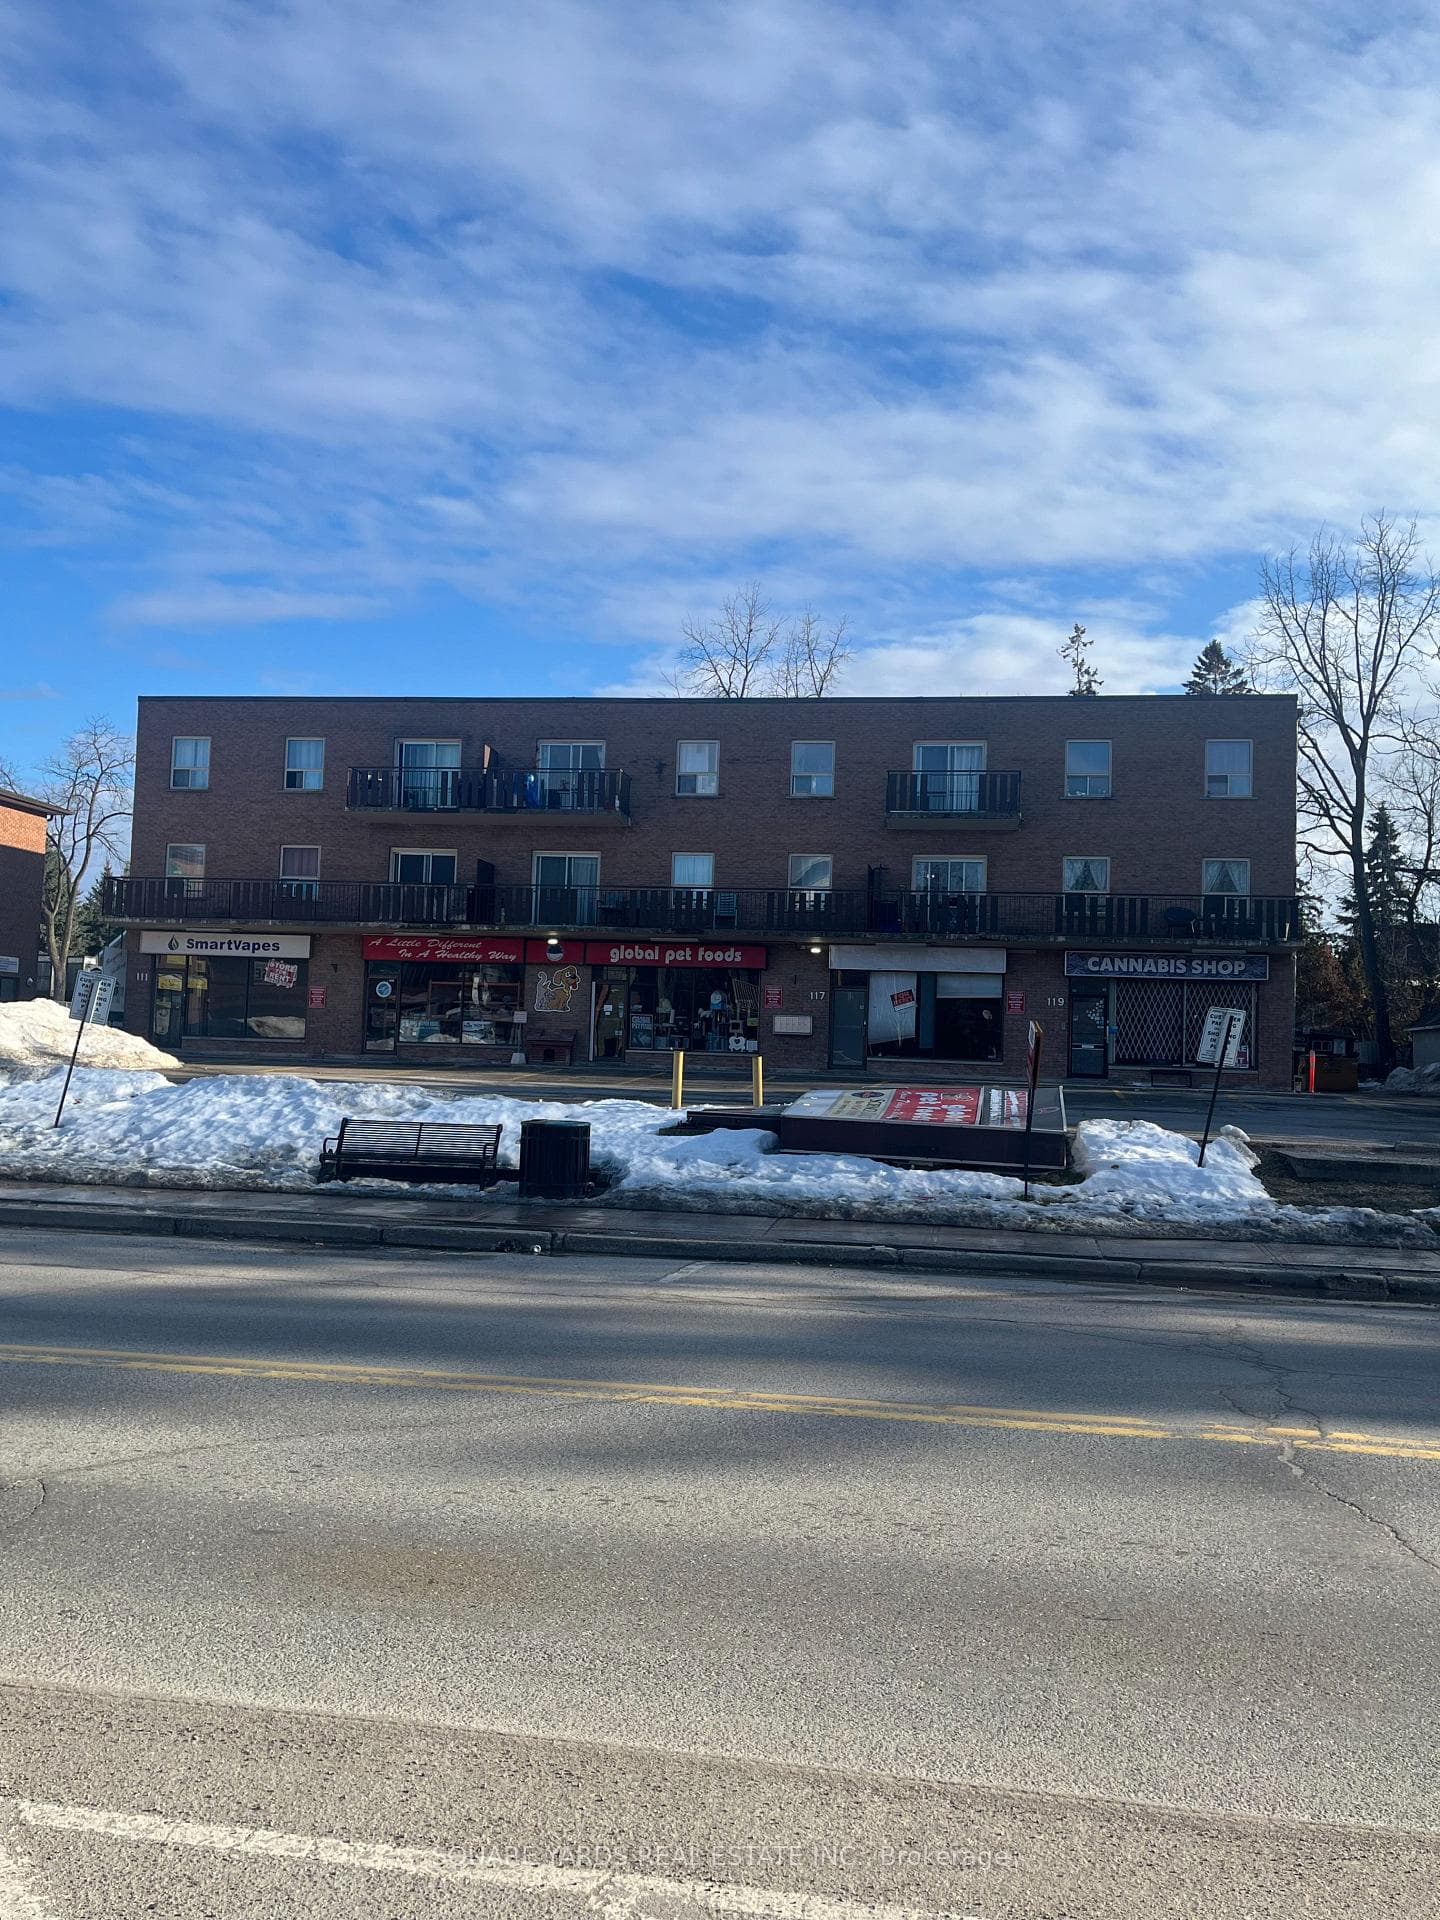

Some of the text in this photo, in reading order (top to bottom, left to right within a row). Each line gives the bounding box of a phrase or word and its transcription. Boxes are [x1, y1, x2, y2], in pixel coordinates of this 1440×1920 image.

[186, 938, 281, 953] SmartVapes
[369, 937, 482, 950] A Little Different
[398, 948, 517, 962] In A Healthy Way
[609, 944, 742, 964] global pet foods
[1087, 956, 1246, 976] CANNABIS SHOP
[810, 991, 826, 1001] 117
[1047, 997, 1065, 1007] 119
